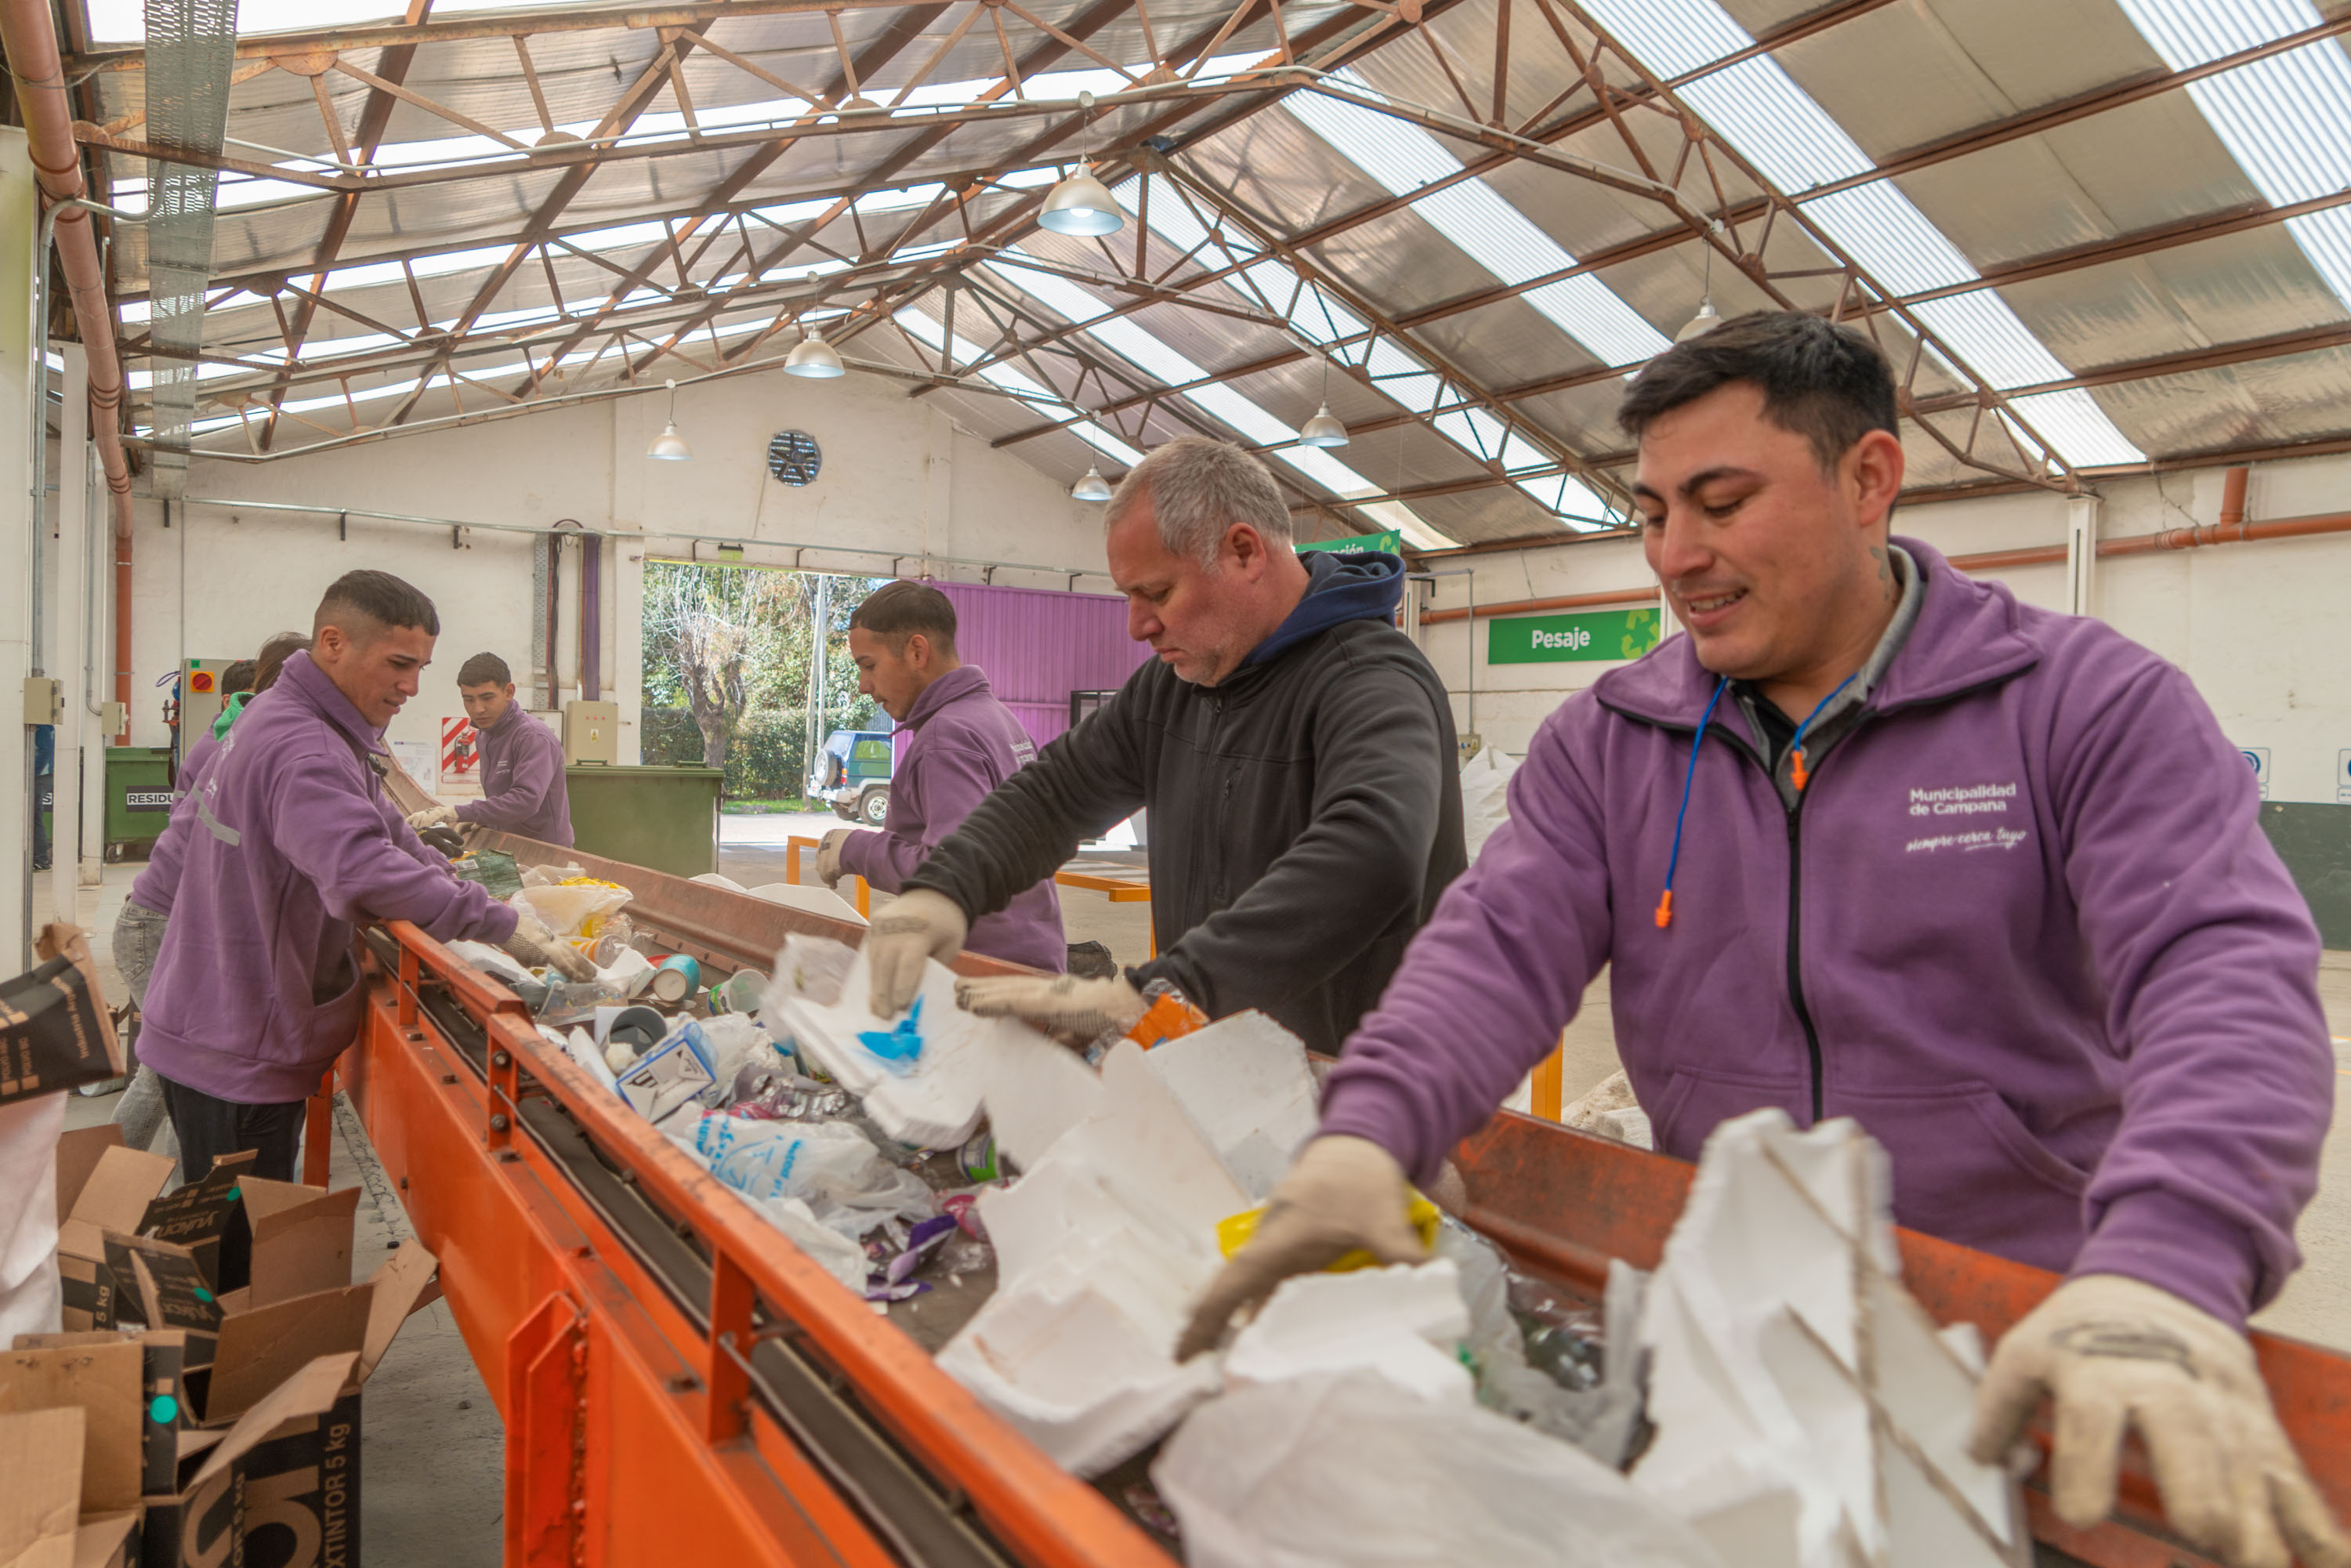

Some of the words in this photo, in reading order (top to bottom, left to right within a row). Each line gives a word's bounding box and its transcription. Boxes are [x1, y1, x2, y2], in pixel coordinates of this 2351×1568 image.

[1532, 626, 1591, 651] Pesaje
[1909, 782, 2016, 802] Municipalidad
[1909, 802, 1930, 816] de
[1933, 800, 2007, 815] Campana
[1905, 835, 1954, 853] siempre
[1956, 831, 1992, 844] cerca
[1997, 826, 2028, 850] tuyo
[71, 1013, 90, 1059] Industria
[324, 1422, 351, 1451] kg
[325, 1454, 346, 1468] 5
